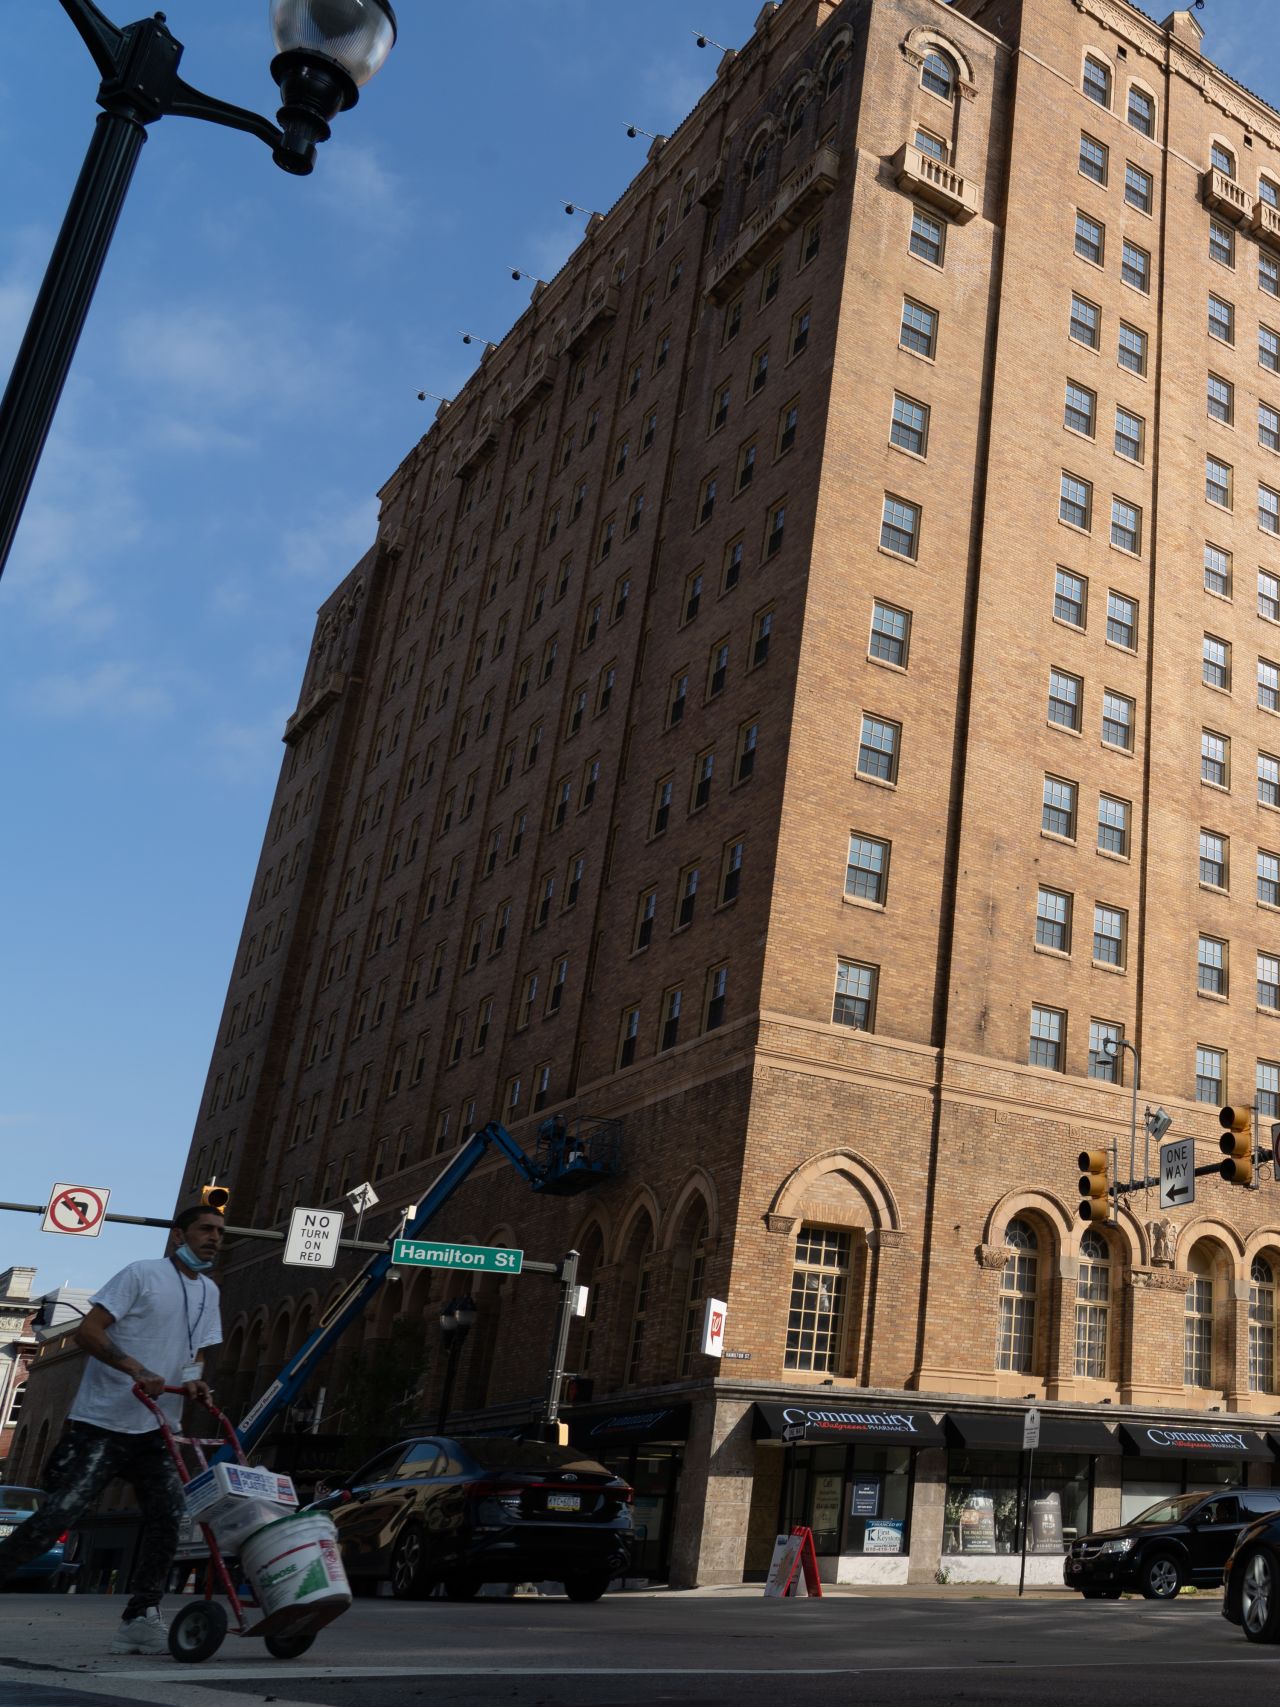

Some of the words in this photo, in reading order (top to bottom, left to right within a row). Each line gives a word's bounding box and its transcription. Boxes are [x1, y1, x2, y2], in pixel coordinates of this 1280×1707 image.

[1166, 1146, 1188, 1163] ONE
[1166, 1162, 1188, 1180] WAY
[304, 1214, 330, 1228] NO
[301, 1228, 330, 1239] TURN
[304, 1240, 321, 1250] ON
[300, 1252, 322, 1262] RED
[400, 1244, 485, 1265] Hamilton
[494, 1252, 516, 1267] St
[783, 1408, 918, 1432] Community
[818, 1421, 868, 1431] Walgreens
[867, 1424, 909, 1432] PHARMACY
[1147, 1429, 1249, 1450] Community
[1175, 1440, 1212, 1449] Walgreens
